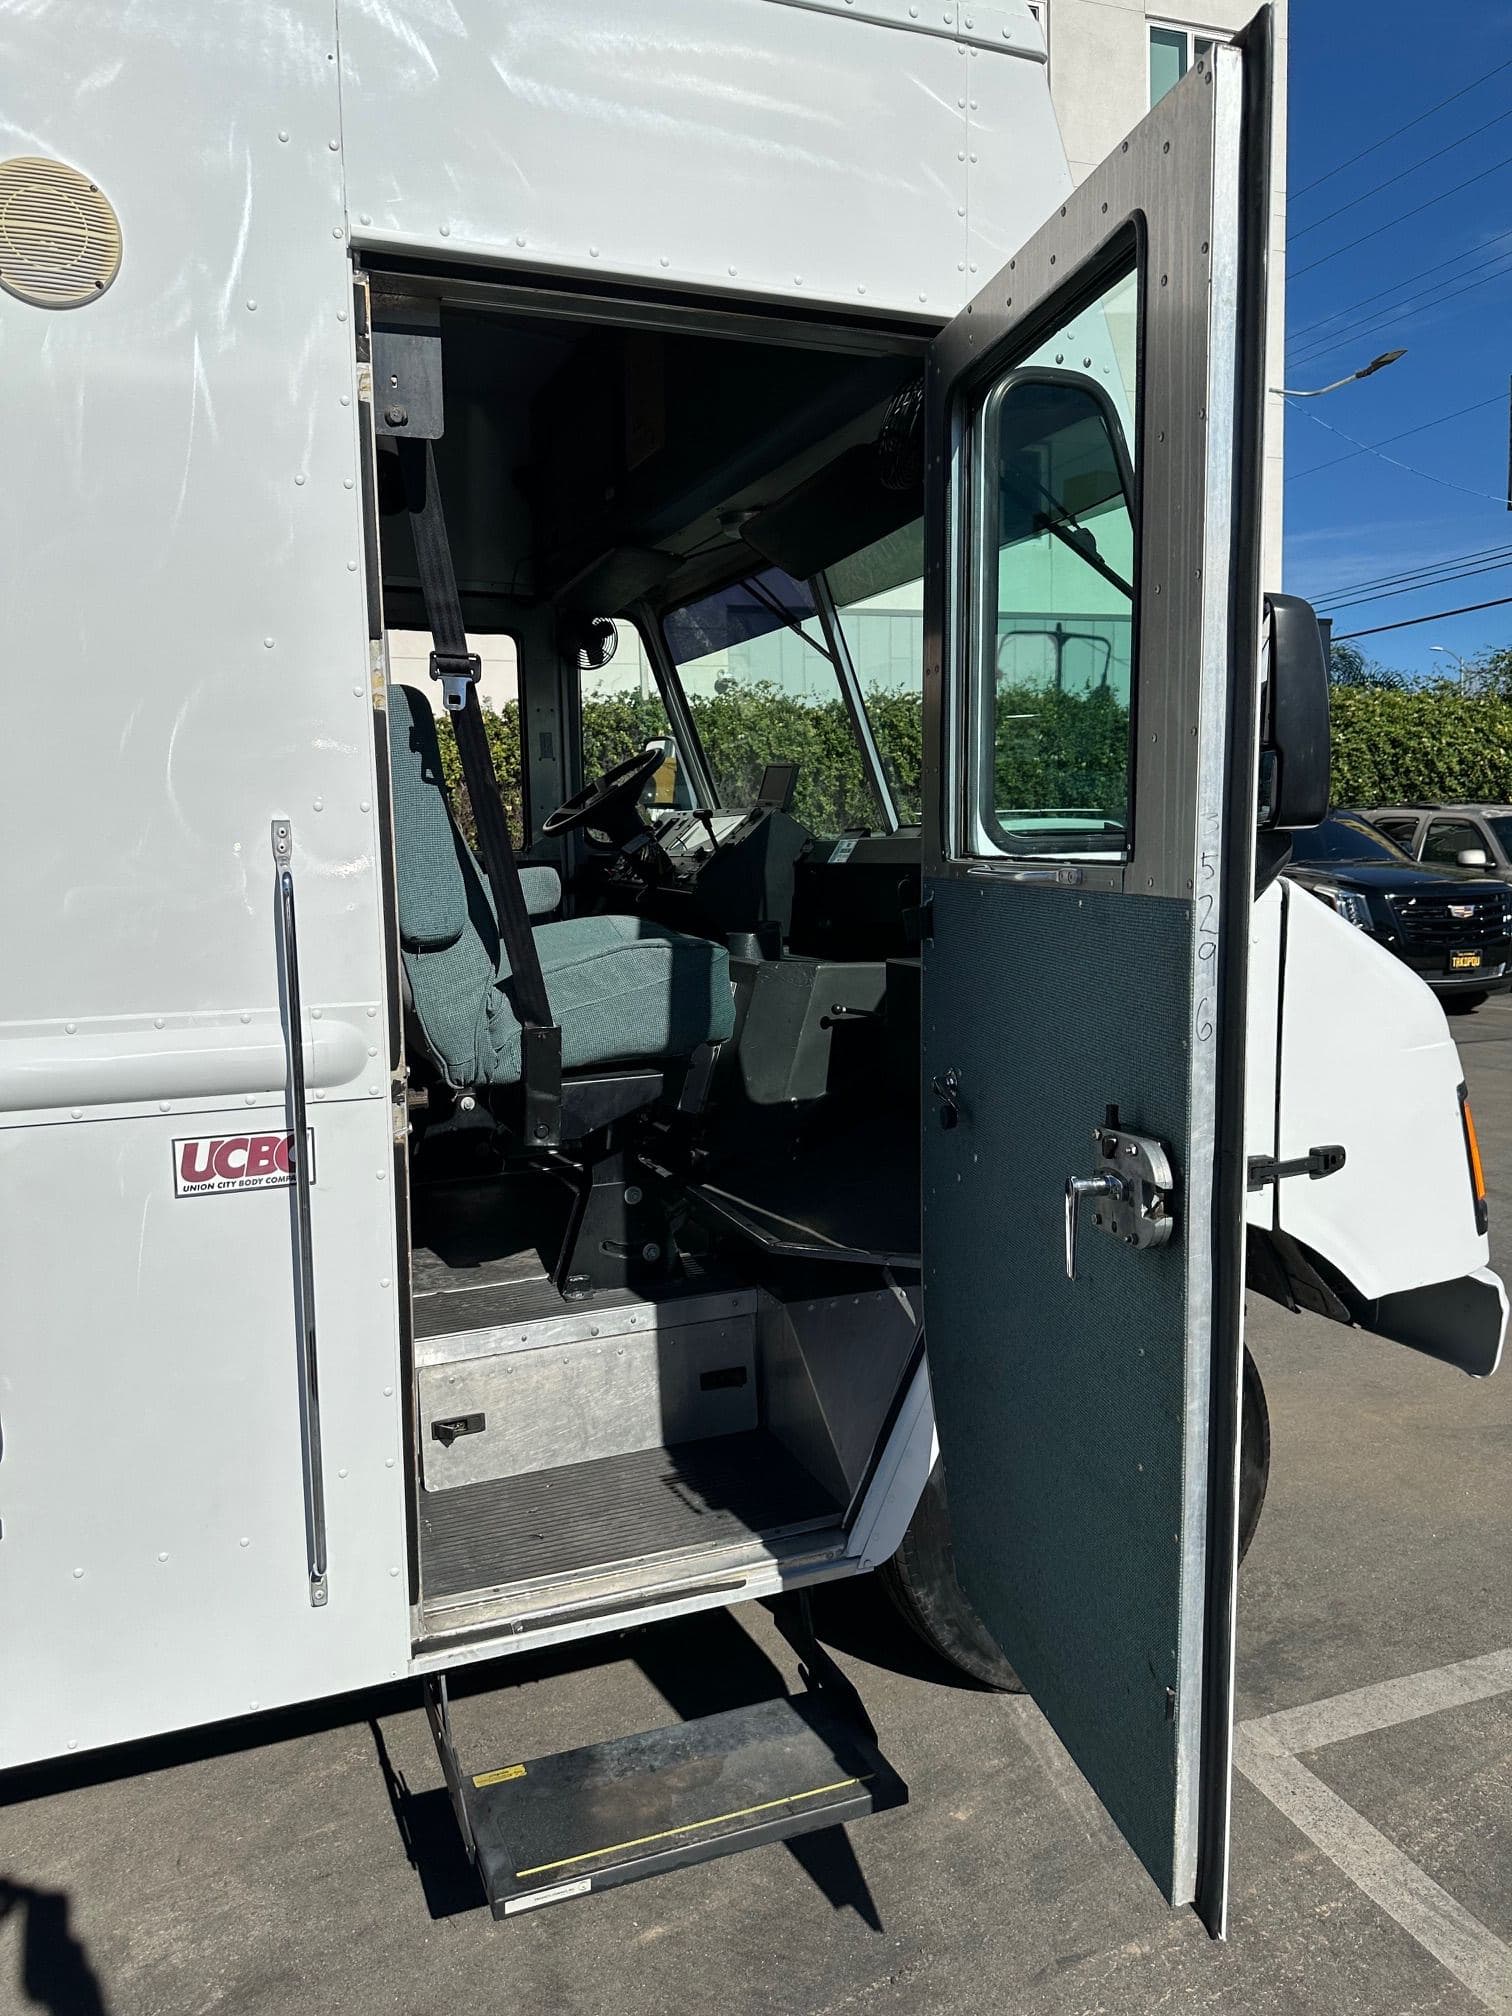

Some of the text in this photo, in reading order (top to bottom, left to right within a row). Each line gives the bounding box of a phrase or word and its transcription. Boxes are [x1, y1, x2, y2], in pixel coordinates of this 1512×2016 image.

[183, 1174, 297, 1192] UNION CITY BODY COMPA
